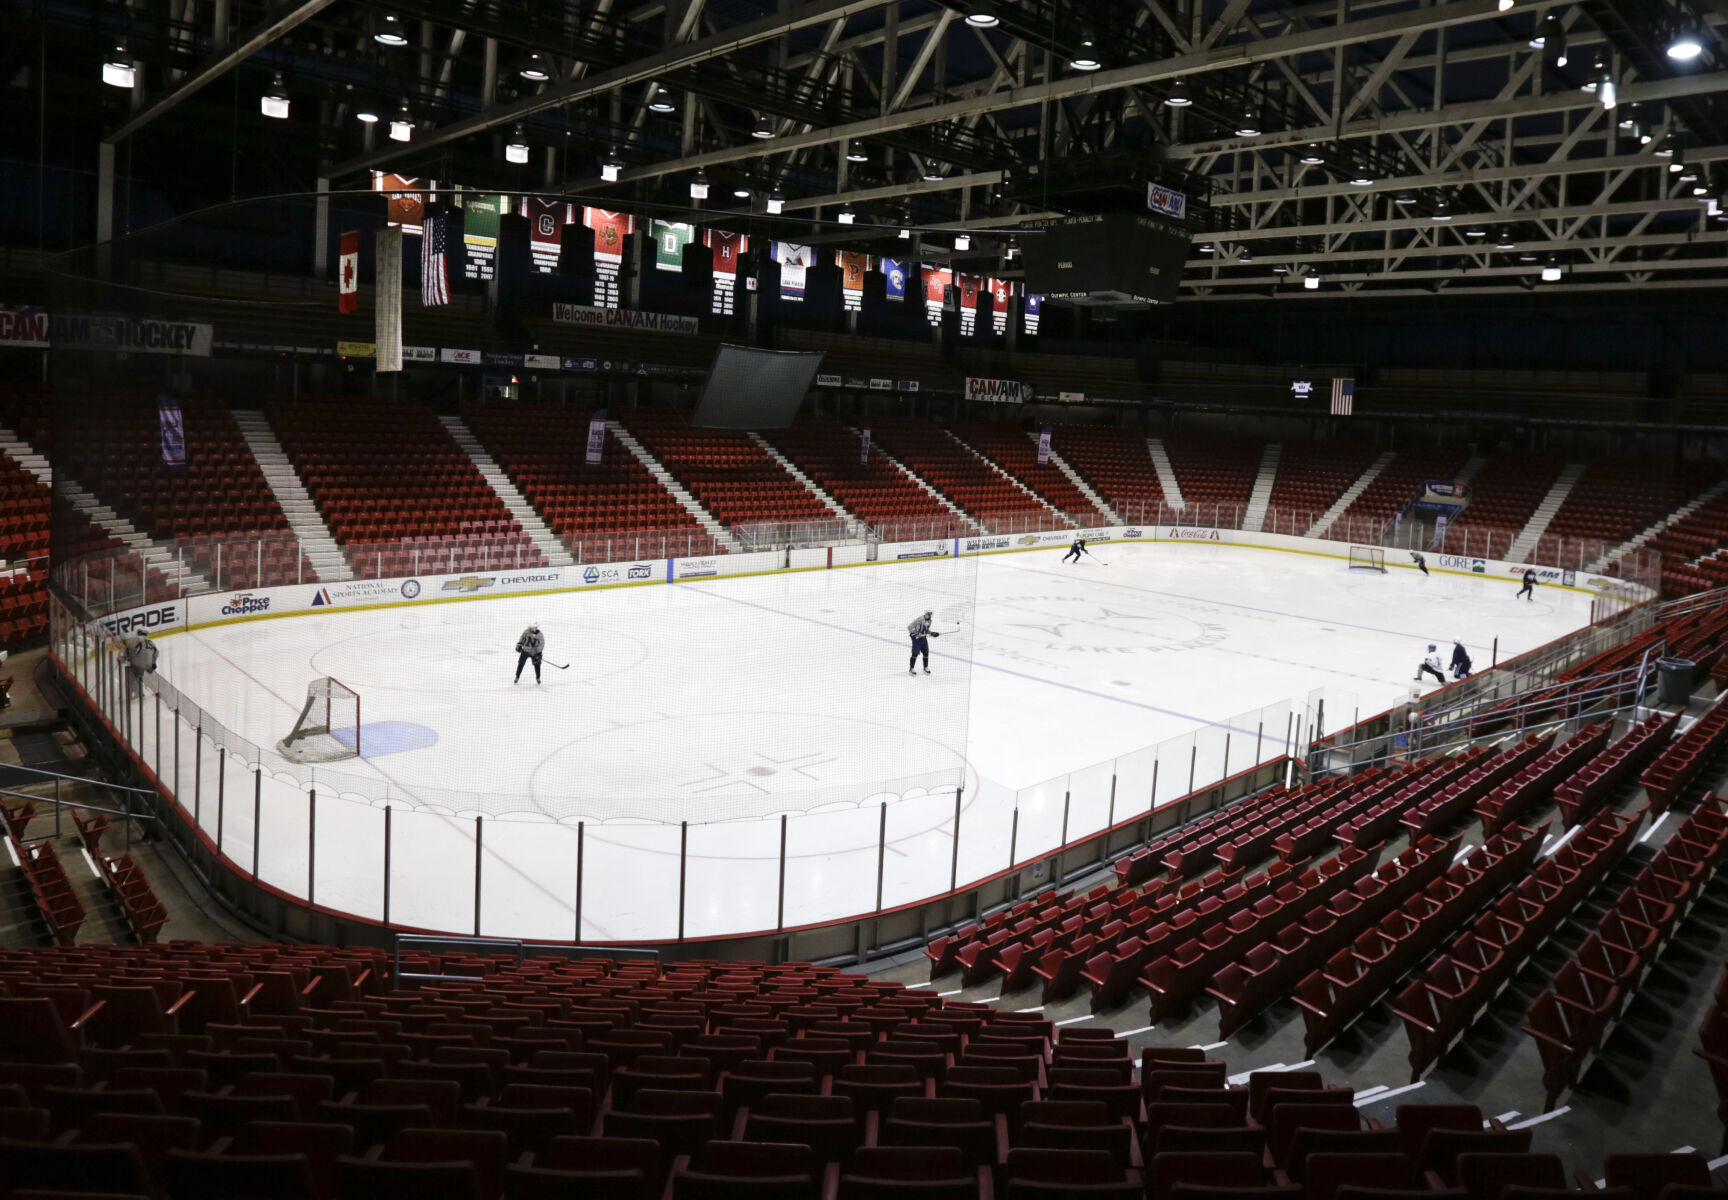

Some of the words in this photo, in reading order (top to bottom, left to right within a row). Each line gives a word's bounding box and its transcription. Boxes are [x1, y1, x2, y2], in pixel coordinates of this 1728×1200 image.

[722, 246, 730, 258] H
[556, 303, 603, 324] Welcome
[606, 309, 657, 329] CAN/AM
[660, 313, 696, 332] Hockey
[118, 319, 196, 349] HOCKEY
[969, 379, 1019, 397] CAN/AM
[1180, 529, 1209, 539] Coca-Cola
[1439, 555, 1471, 570] GORE
[601, 569, 619, 578] SCA
[629, 567, 650, 578] TORK
[1509, 566, 1561, 579] CA/AM
[501, 573, 561, 585] CHEVROLET
[242, 597, 270, 606] Price
[221, 603, 270, 615] Chopper
